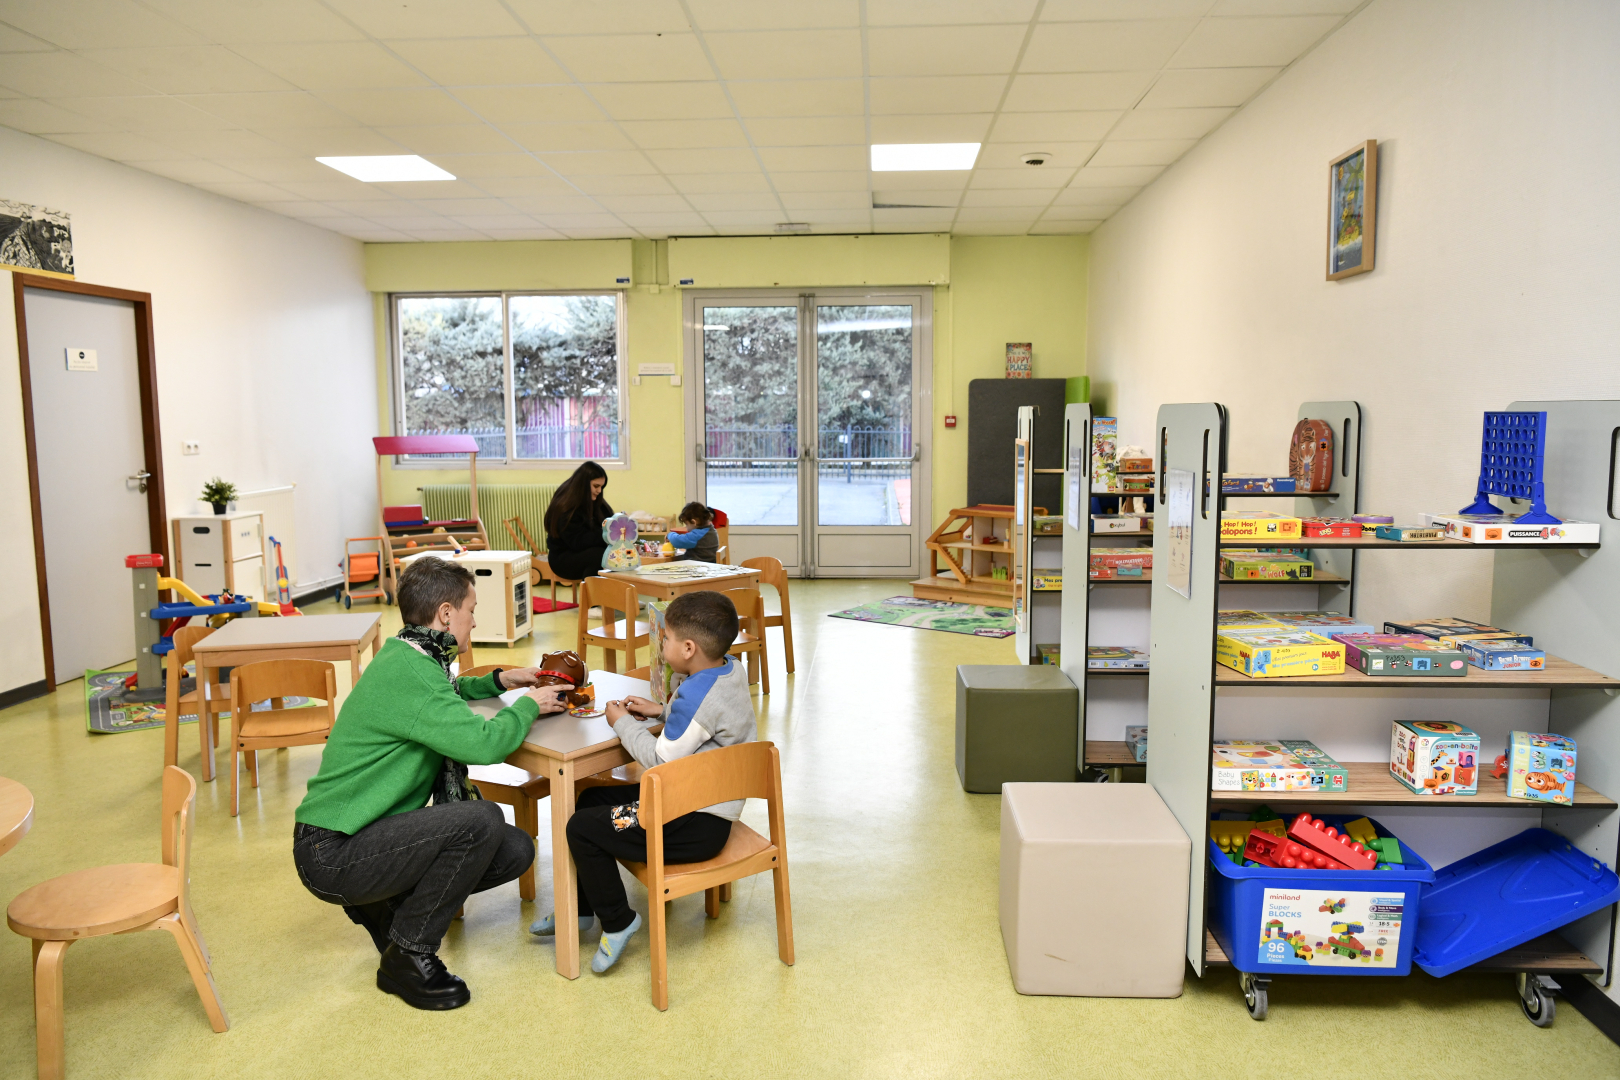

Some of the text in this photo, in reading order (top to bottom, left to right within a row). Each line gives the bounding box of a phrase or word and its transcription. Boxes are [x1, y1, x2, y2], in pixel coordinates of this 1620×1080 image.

[1007, 356, 1030, 364] HAPPY
[1241, 520, 1257, 528] Hop!
[1220, 527, 1258, 536] alopons!
[1540, 527, 1549, 539] 4
[1267, 570, 1285, 578] WOLF
[1322, 651, 1340, 660] HABA
[1217, 778, 1240, 786] Shapes
[1267, 942, 1285, 953] 96
